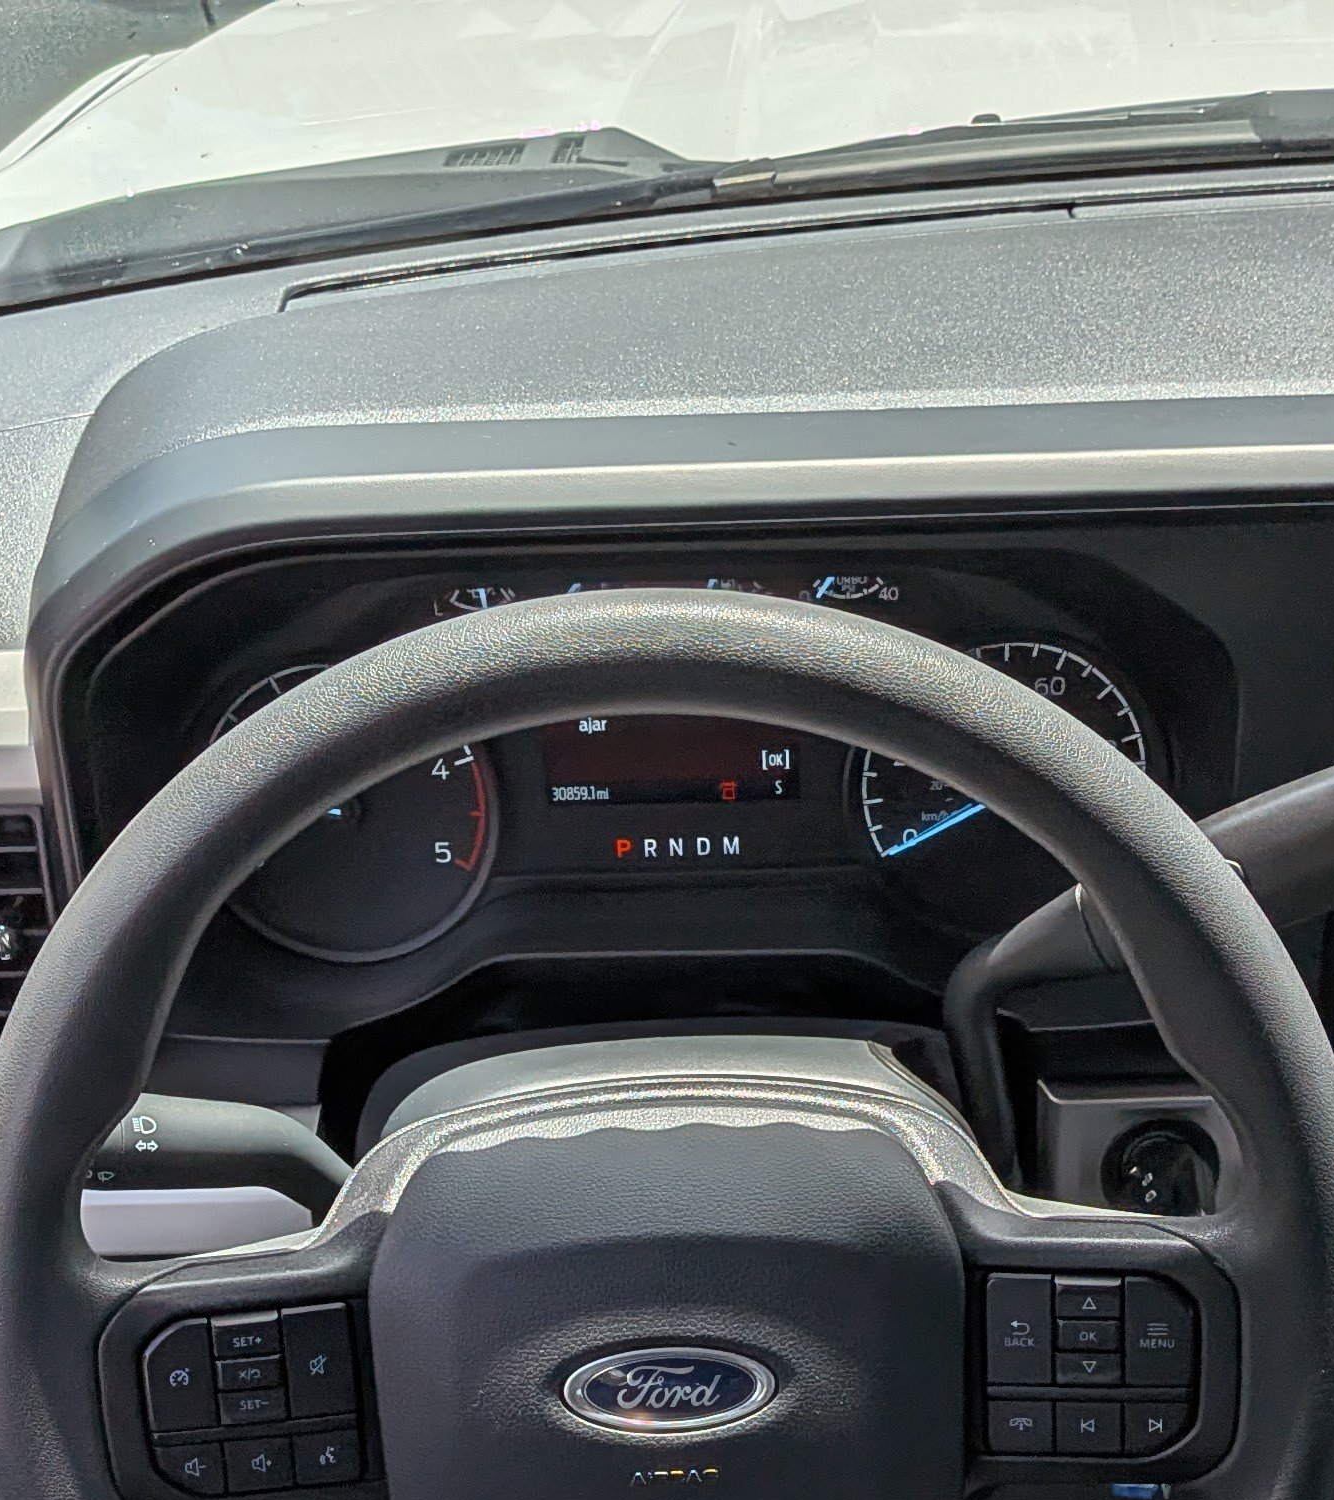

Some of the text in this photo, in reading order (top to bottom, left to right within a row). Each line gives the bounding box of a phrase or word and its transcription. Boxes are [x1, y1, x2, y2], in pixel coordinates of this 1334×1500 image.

[878, 586, 899, 601] 40
[1033, 676, 1066, 697] 60
[578, 717, 608, 734] ajar
[431, 758, 450, 780] 4
[551, 785, 596, 801] 30859.1
[773, 779, 784, 795] S
[434, 841, 452, 864] 5
[615, 836, 741, 858] P R N D M
[1003, 1337, 1036, 1348] BACK
[1078, 1331, 1097, 1342] OK
[1138, 1337, 1175, 1349] MENU
[616, 1364, 723, 1411] Ford
